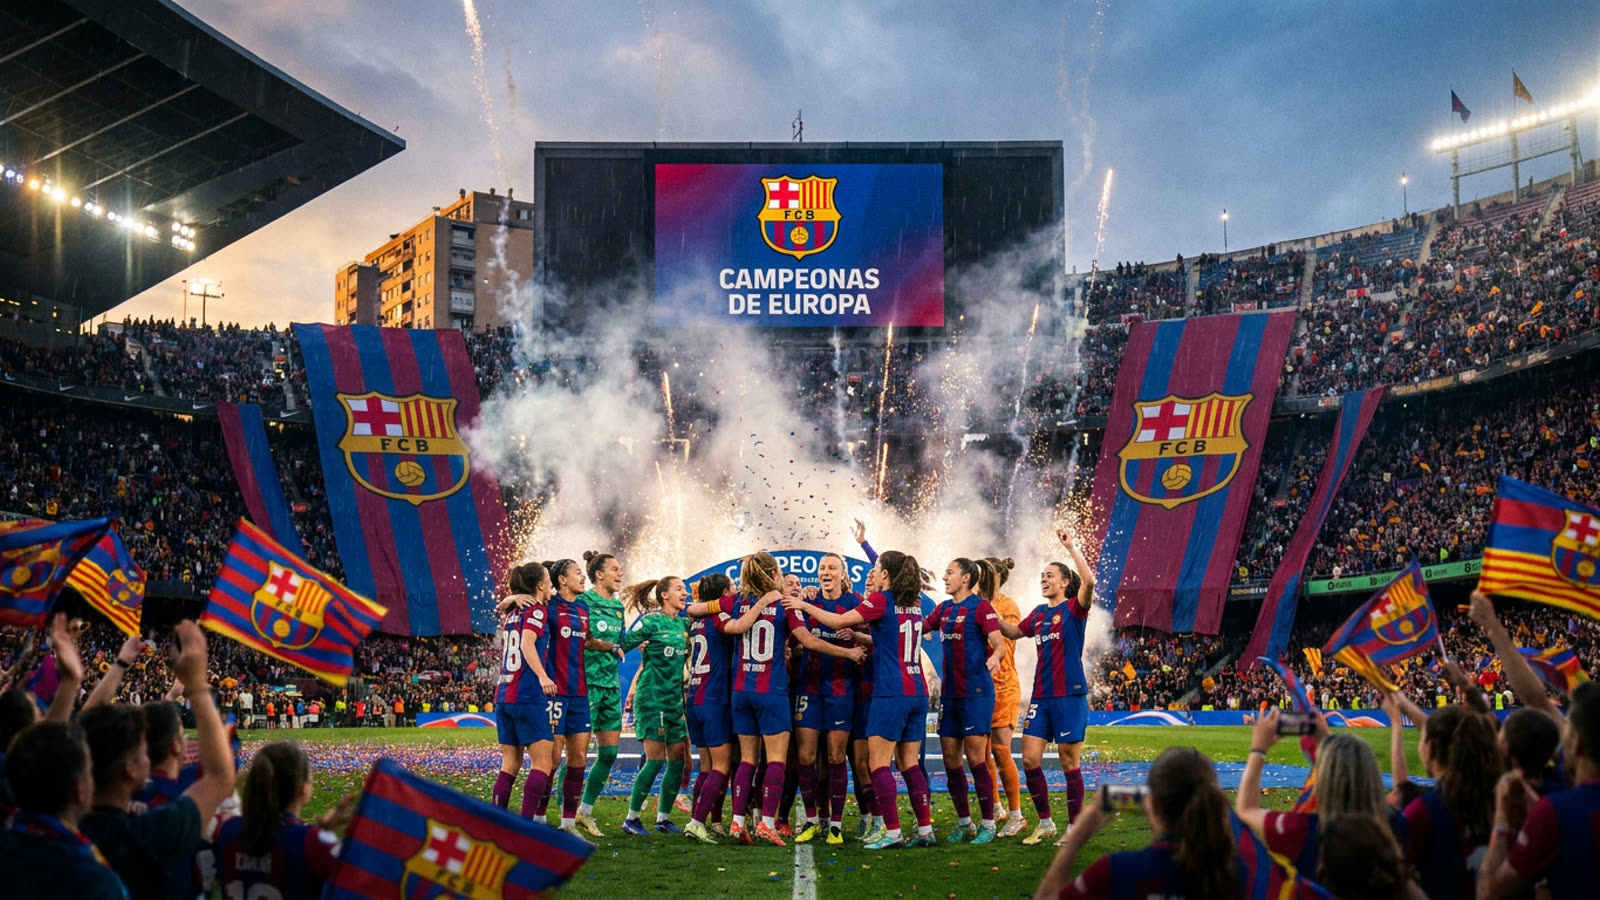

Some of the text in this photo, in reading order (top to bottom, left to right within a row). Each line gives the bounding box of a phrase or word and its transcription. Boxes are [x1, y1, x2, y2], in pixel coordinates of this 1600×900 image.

[784, 210, 815, 220] FCB
[719, 268, 880, 290] CAMPEONAS
[728, 293, 872, 315] DE EUROPA
[380, 438, 429, 453] FCB
[1159, 440, 1207, 456] FCB
[742, 619, 775, 662] 10
